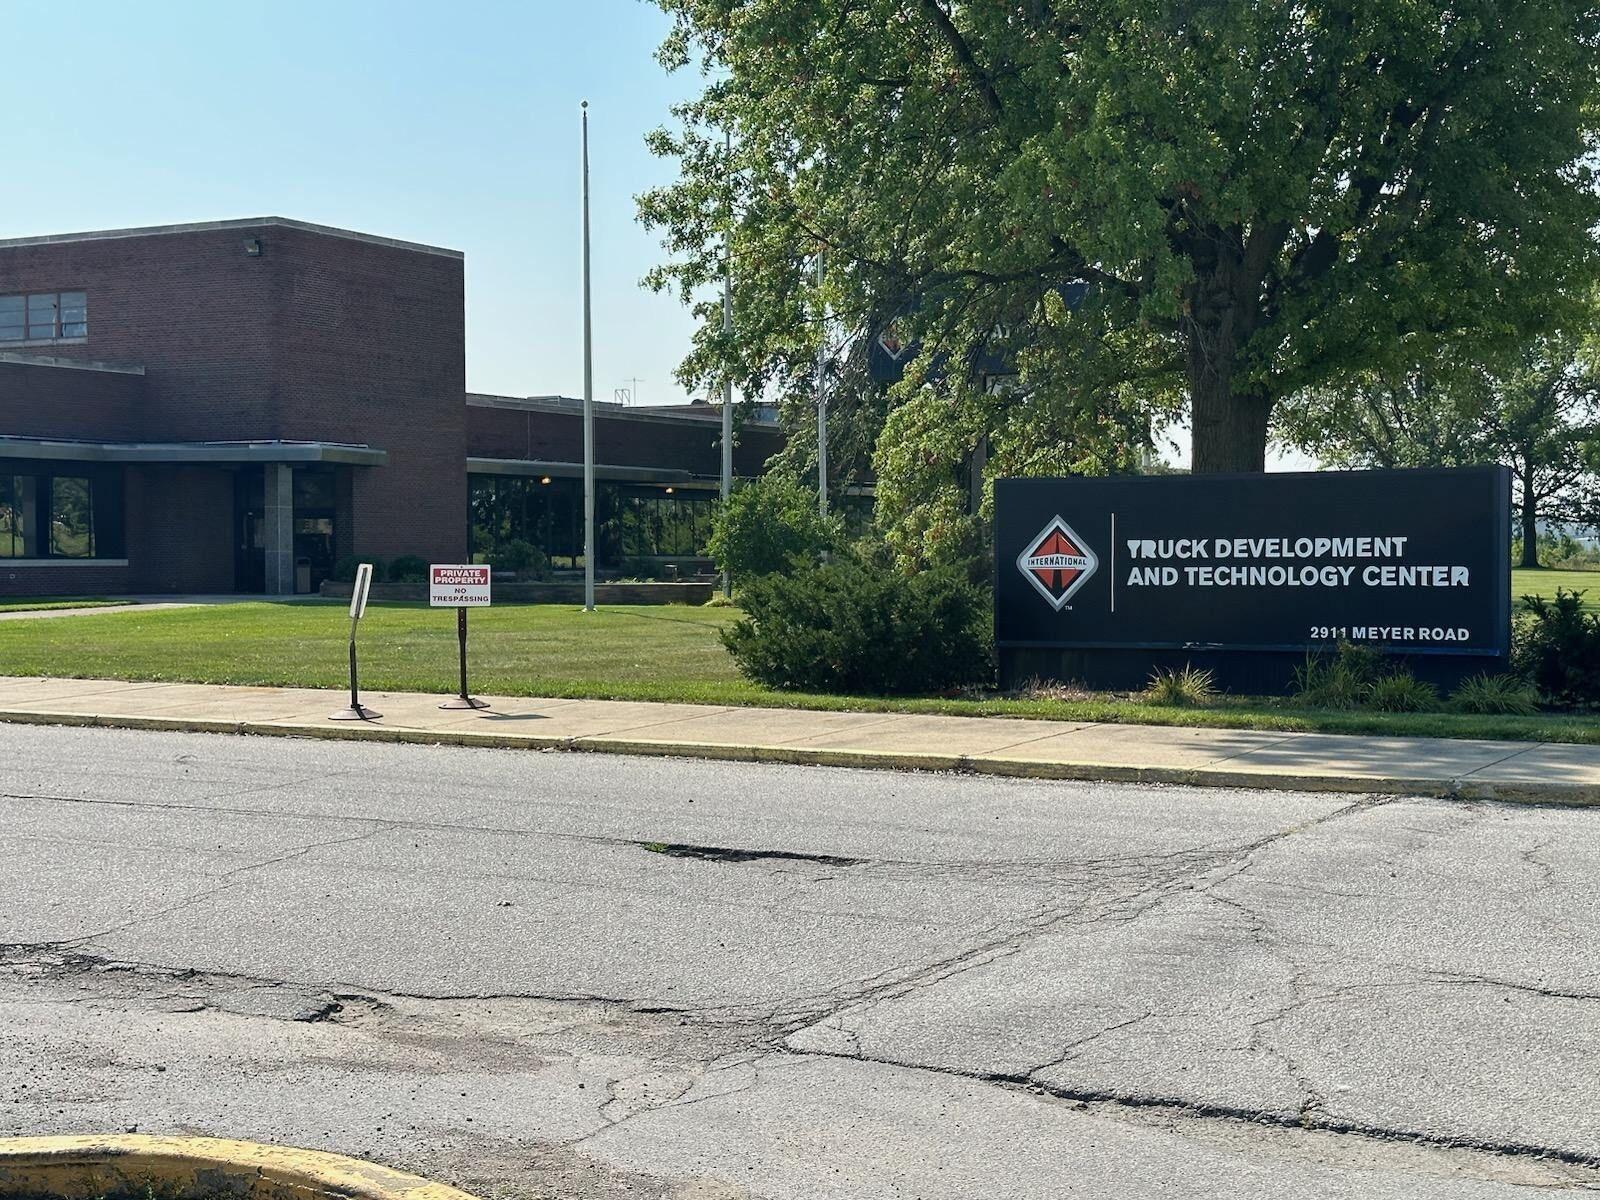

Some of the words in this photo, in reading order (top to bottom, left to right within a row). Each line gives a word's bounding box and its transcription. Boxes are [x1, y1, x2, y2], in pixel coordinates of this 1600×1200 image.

[1127, 539, 1209, 559] TRUCK
[1214, 536, 1408, 558] DEVELOPMENT
[1027, 556, 1087, 566] INTERNATIONAL
[1127, 566, 1179, 586] AND
[1184, 565, 1356, 587] TECHNOLOGY
[1362, 565, 1470, 587] CENTER
[1310, 626, 1347, 639] 2911
[1352, 626, 1415, 640] MEYER
[1418, 627, 1470, 641] ROAD
